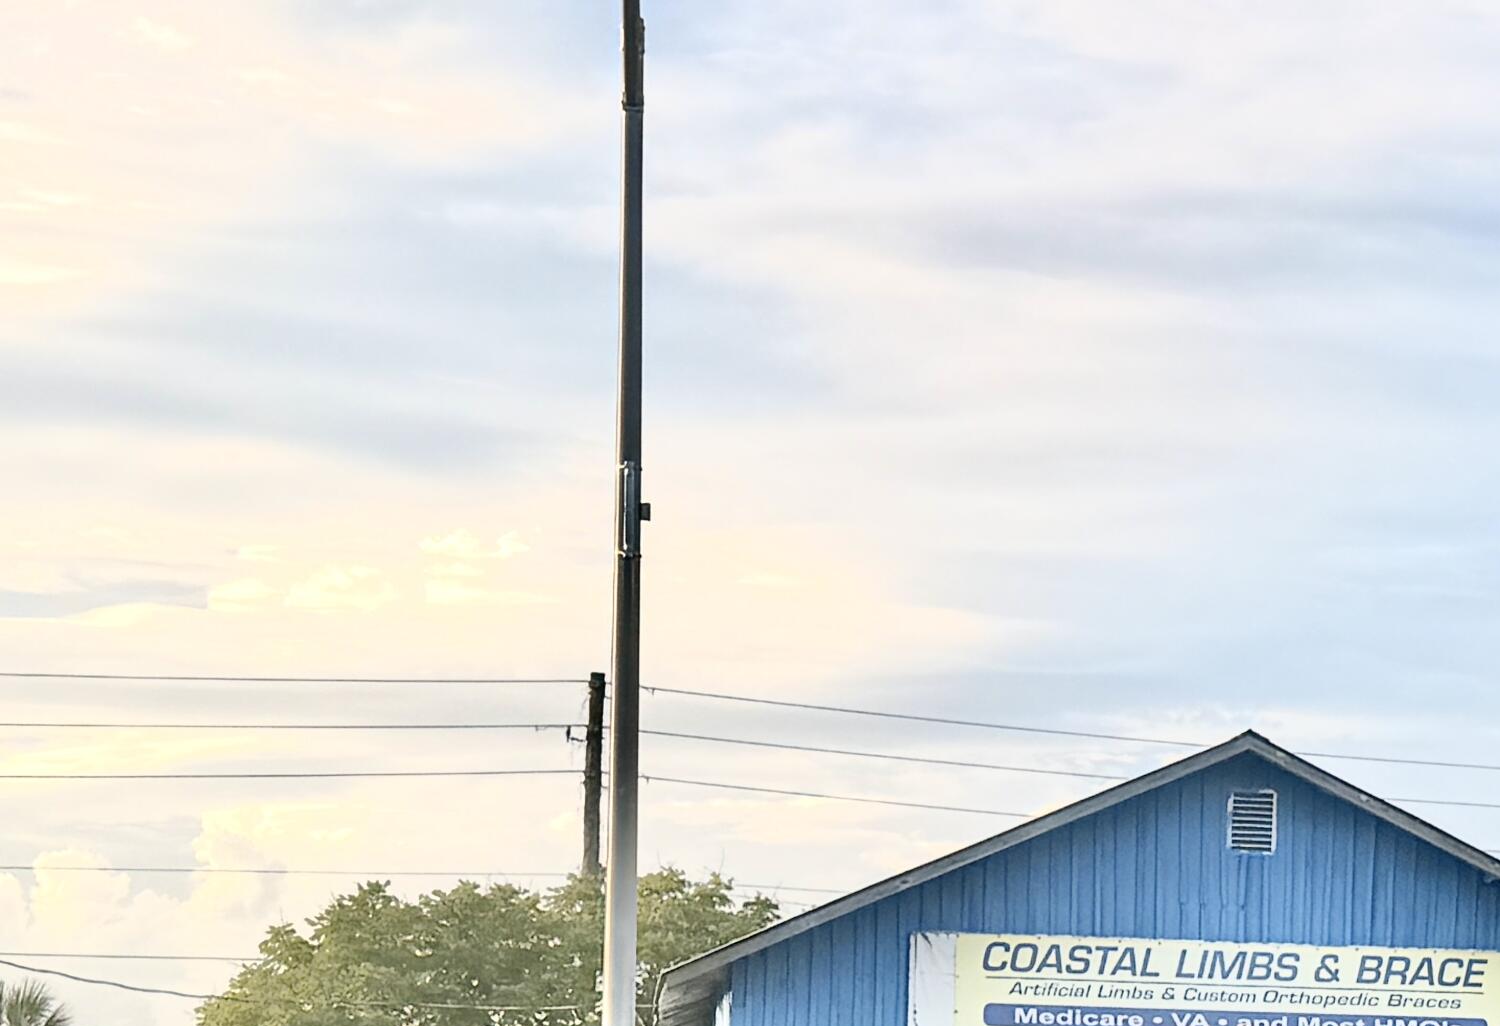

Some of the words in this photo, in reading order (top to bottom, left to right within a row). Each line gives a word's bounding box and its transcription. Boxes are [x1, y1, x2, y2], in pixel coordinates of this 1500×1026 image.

[982, 941, 1160, 977] COASTAL
[1175, 948, 1301, 982] LIMBS
[1314, 954, 1340, 983] &
[1355, 955, 1489, 988] BRACE
[1008, 981, 1092, 999] Artificial
[1097, 985, 1154, 1000] Limbs
[1161, 987, 1176, 1001] &
[1183, 987, 1257, 1003] Custom
[1264, 990, 1380, 1009] Orthopedic
[1387, 994, 1462, 1010] Braces
